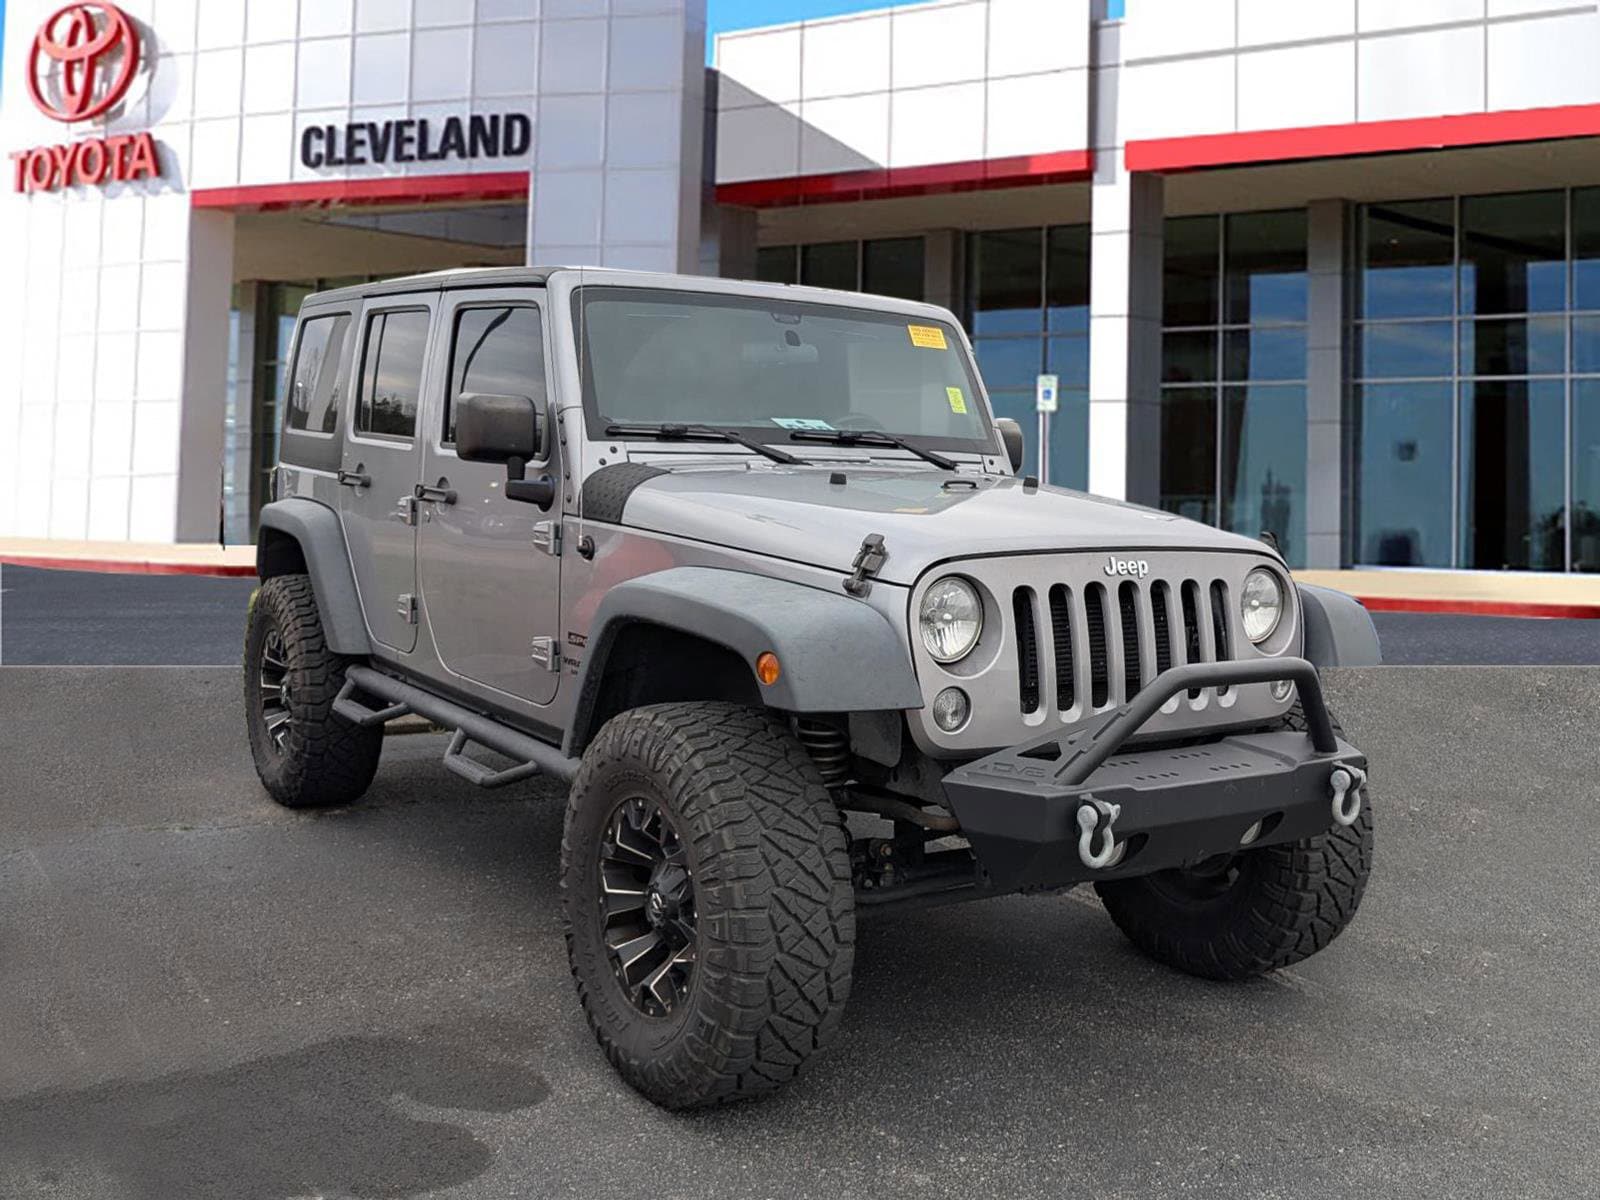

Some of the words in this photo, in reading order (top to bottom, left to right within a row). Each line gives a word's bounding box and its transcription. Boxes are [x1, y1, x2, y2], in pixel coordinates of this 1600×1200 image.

[9, 131, 161, 193] TOYOTA
[301, 113, 531, 169] CLEVELAND
[1104, 556, 1149, 579] Jeep
